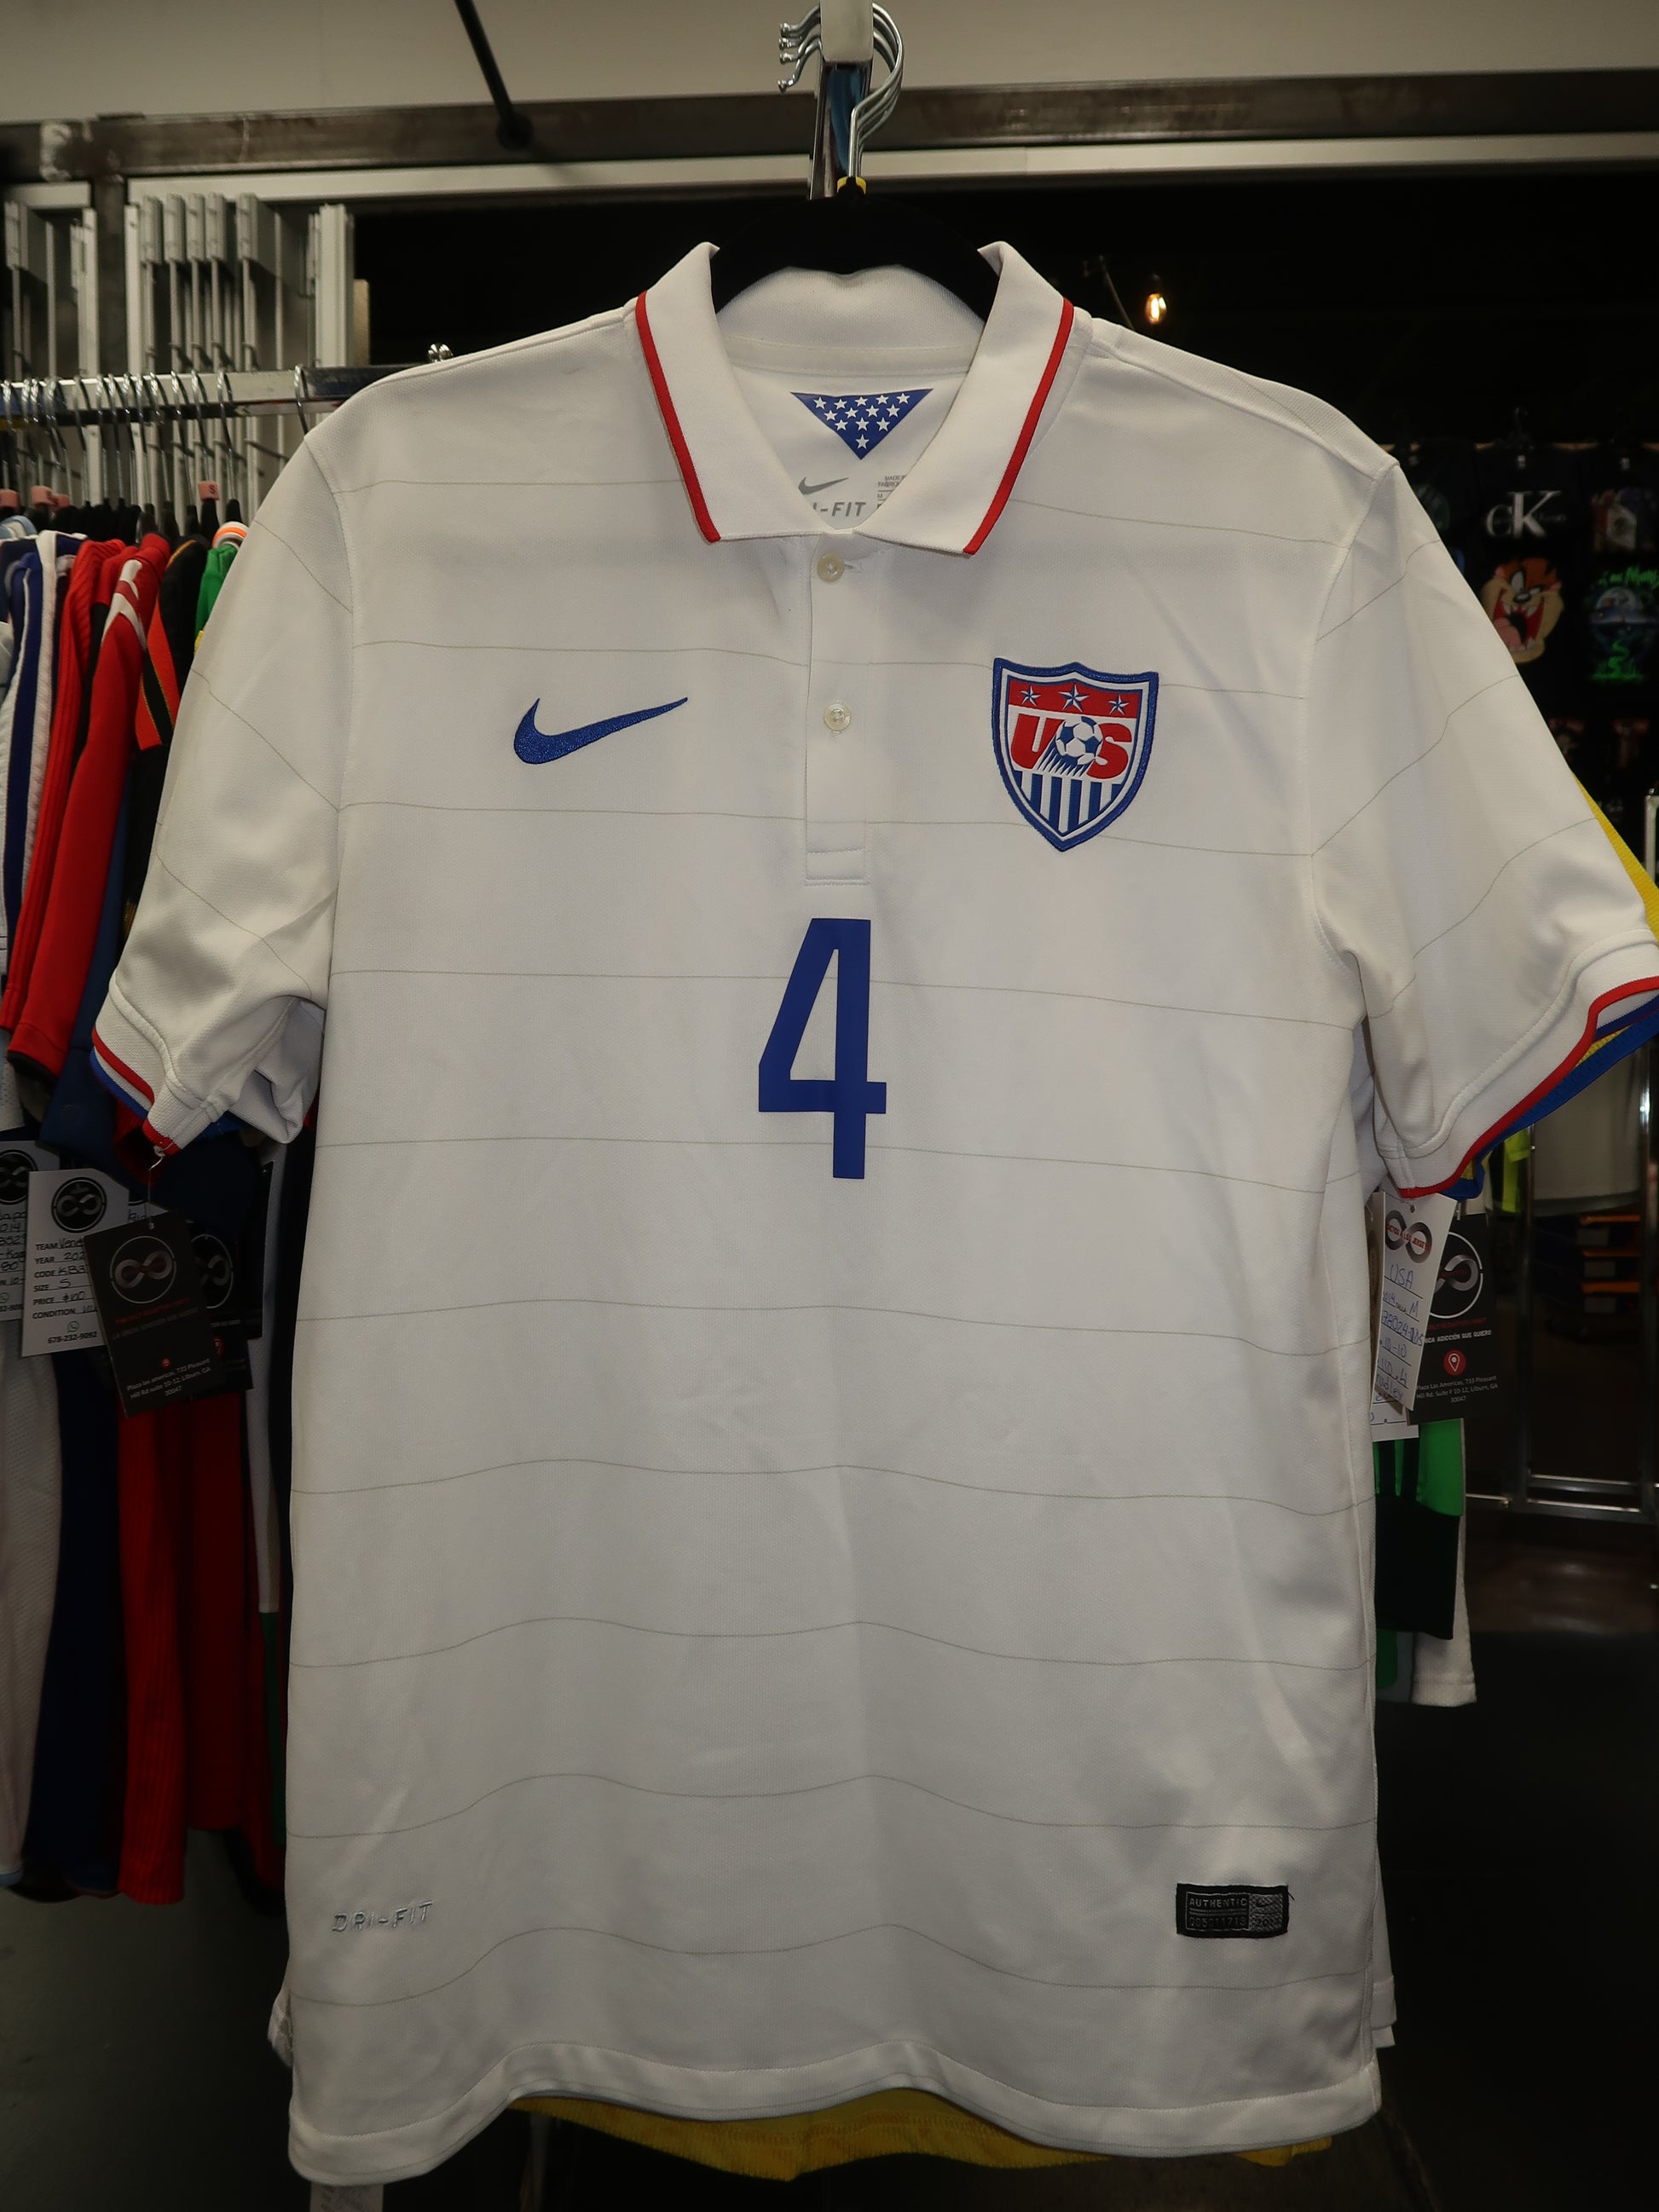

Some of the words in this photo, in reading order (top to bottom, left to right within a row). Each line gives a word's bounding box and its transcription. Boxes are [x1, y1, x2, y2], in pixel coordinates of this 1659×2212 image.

[1010, 713, 1132, 780] US
[758, 918, 887, 1180] 4
[36, 1242, 58, 1250] TEAM
[34, 1269, 55, 1279] CODE
[1390, 1263, 1413, 1290] USA
[33, 1284, 49, 1292] SIZE
[33, 1297, 55, 1306] PRICE
[32, 1308, 76, 1320] CONDITION
[1189, 1897, 1248, 1908] AUTHENTIC
[331, 1899, 434, 1932] DRI-FIT
